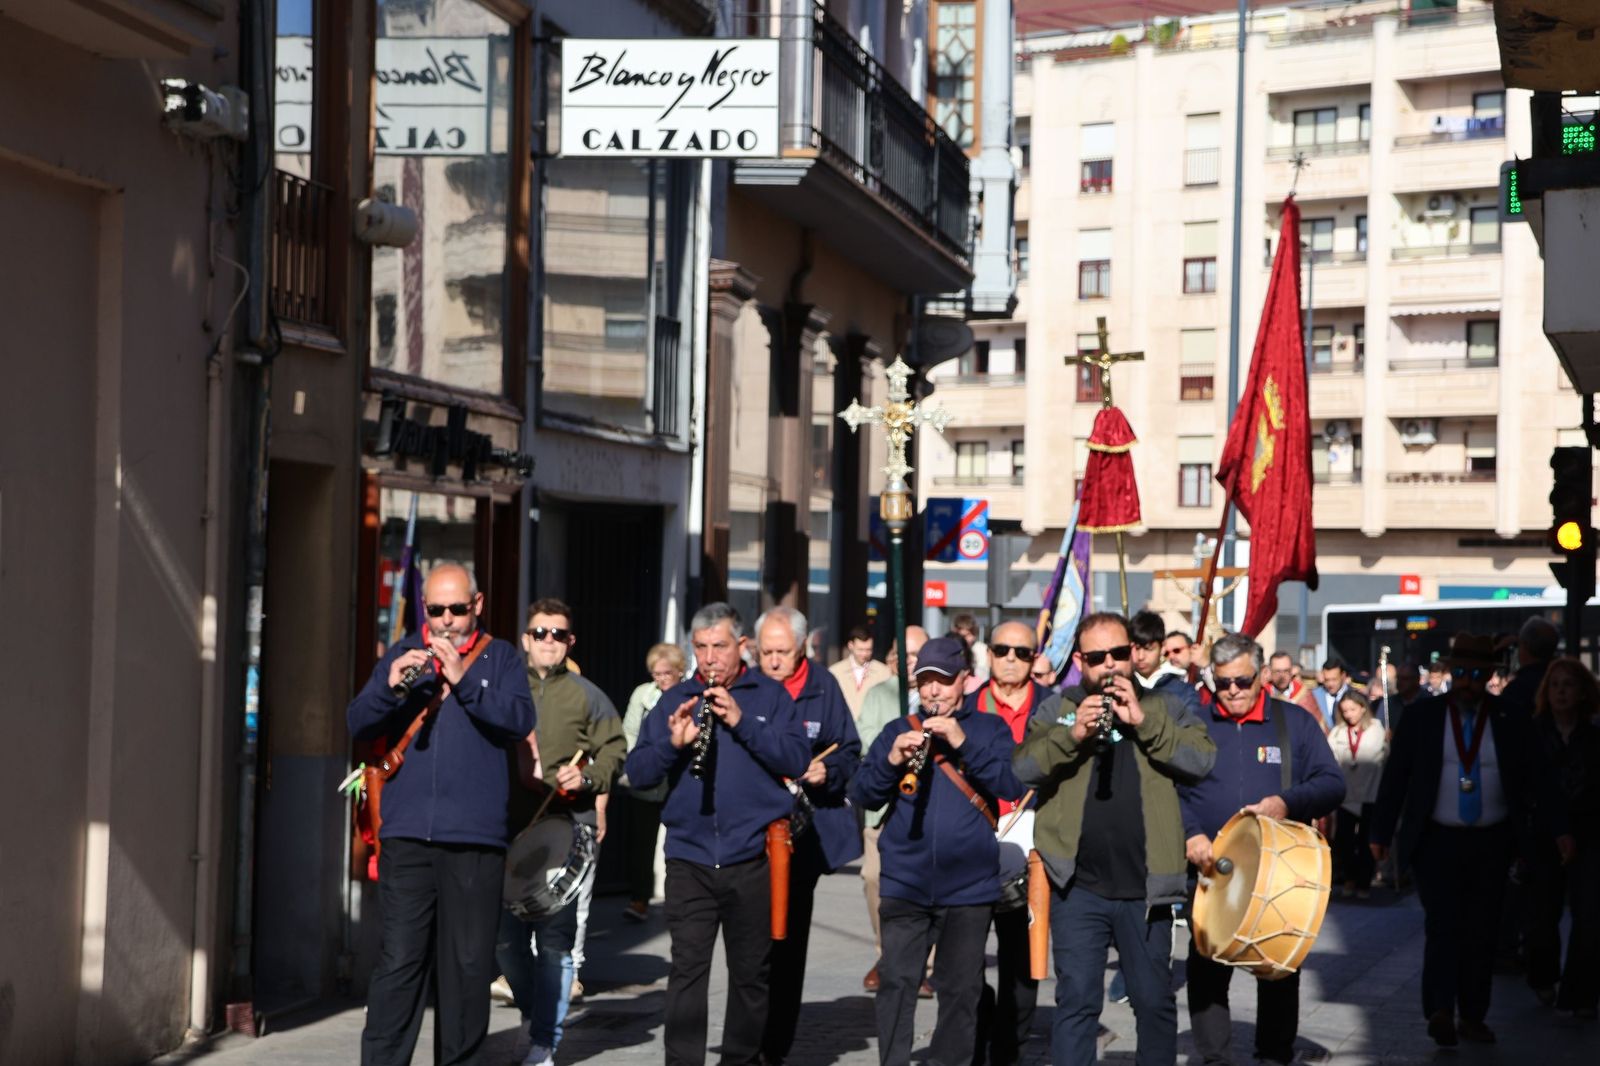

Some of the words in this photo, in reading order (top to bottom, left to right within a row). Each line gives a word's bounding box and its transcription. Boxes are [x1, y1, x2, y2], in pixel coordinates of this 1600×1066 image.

[568, 49, 673, 93] Blanco
[656, 73, 695, 123] y
[700, 46, 772, 111] Negro
[582, 128, 758, 151] CALZADO
